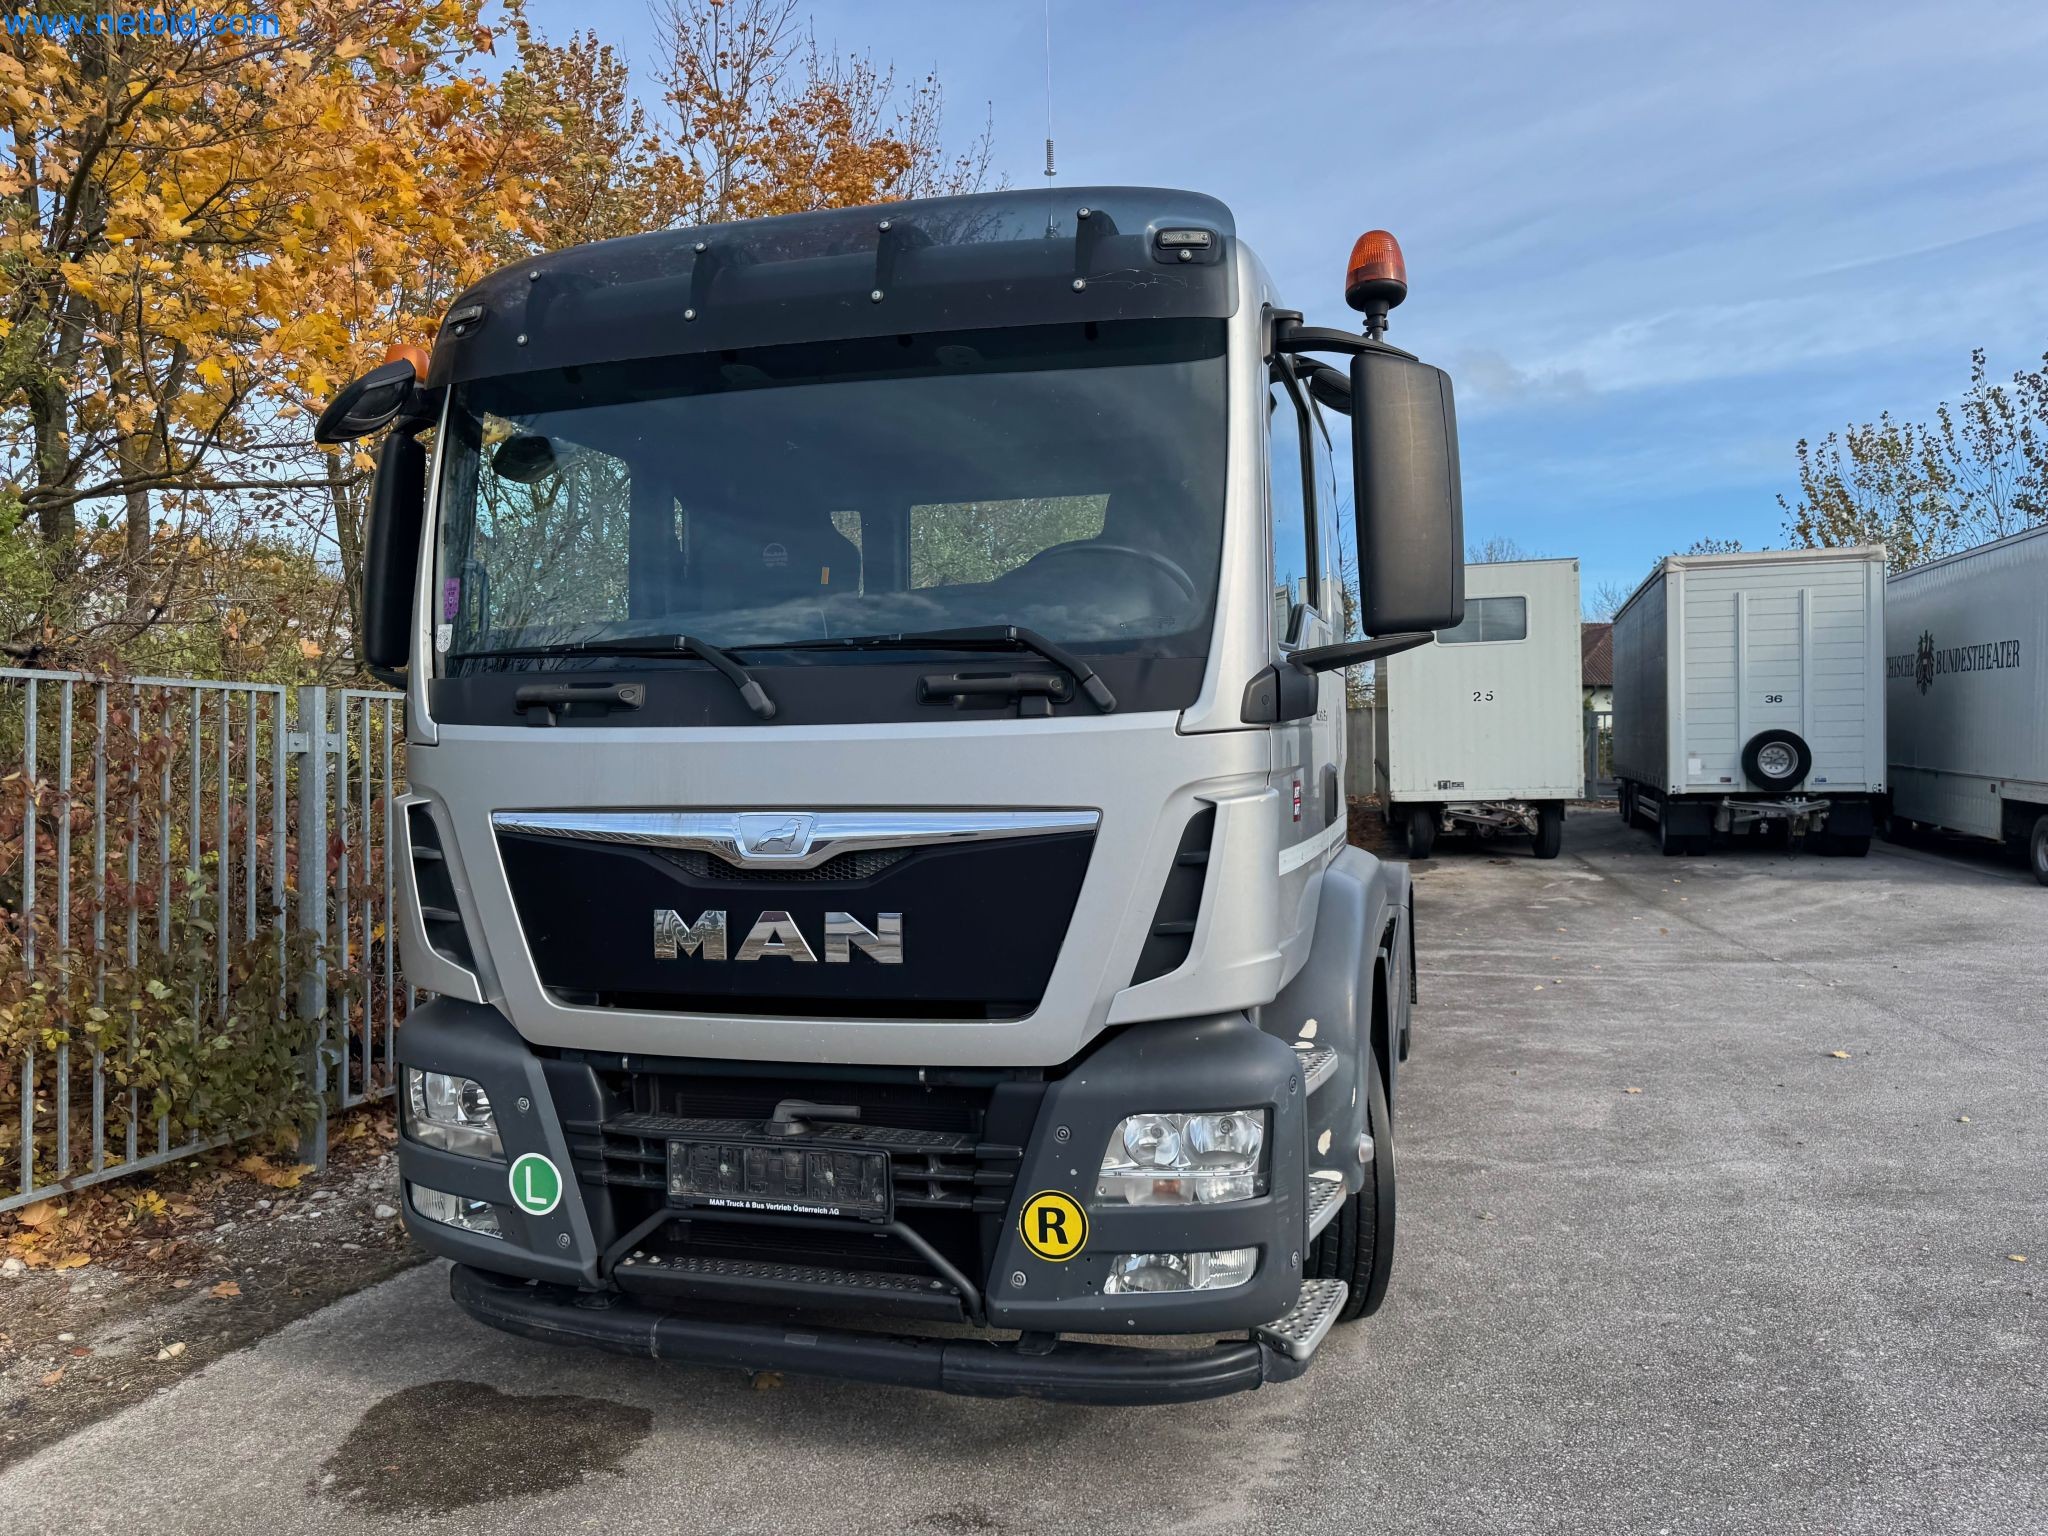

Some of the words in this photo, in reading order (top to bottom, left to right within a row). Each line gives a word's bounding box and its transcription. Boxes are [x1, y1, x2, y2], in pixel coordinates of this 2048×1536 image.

[1936, 640, 2020, 674] BUNDESTHEATER
[1473, 690, 1494, 702] 25
[1765, 694, 1783, 704] 36
[654, 909, 903, 964] MAN
[525, 1165, 548, 1205] L
[709, 1198, 725, 1206] MAN
[726, 1199, 744, 1208] Truck
[751, 1201, 765, 1209] Bus
[766, 1202, 792, 1211] Vertrieb
[793, 1203, 828, 1214] Österreich
[828, 1207, 840, 1215] AG
[1037, 1206, 1069, 1245] R
